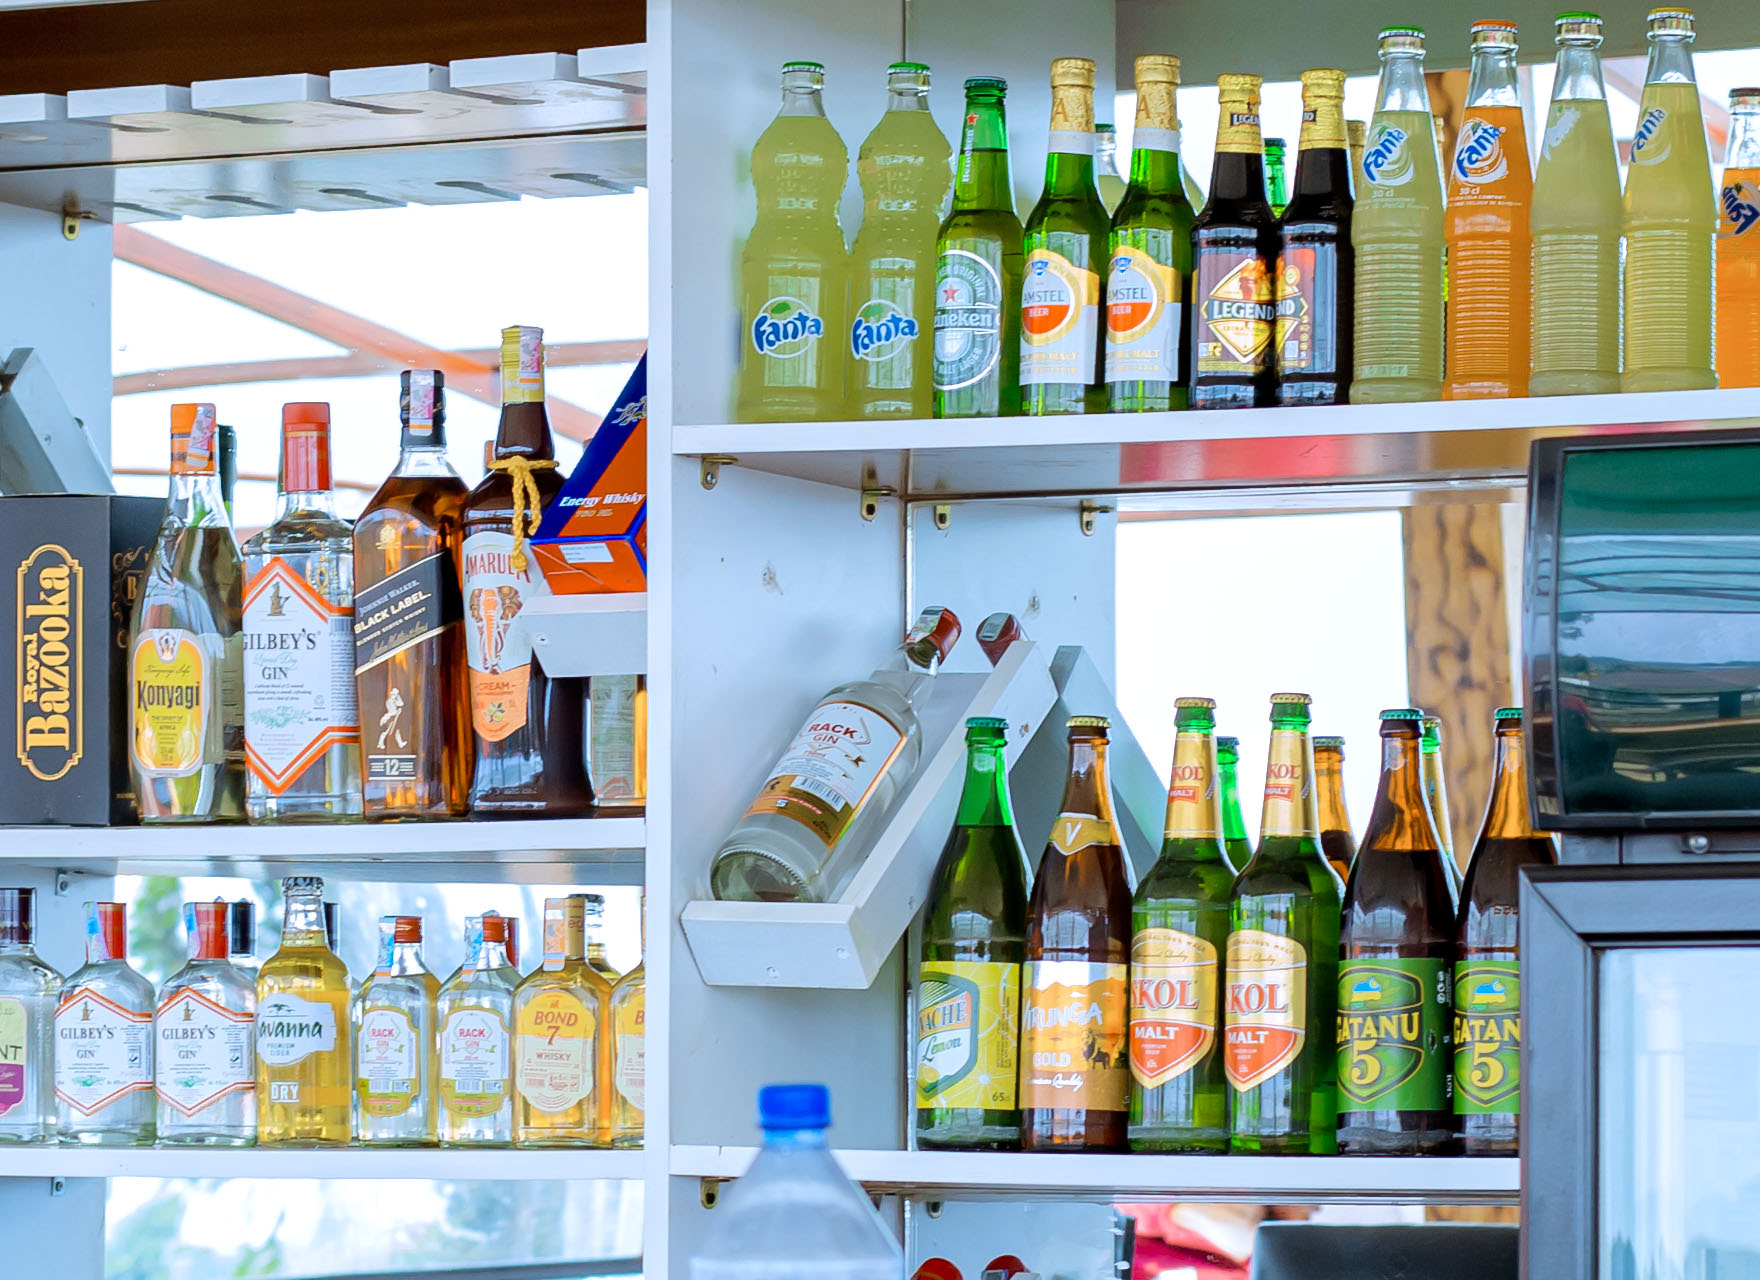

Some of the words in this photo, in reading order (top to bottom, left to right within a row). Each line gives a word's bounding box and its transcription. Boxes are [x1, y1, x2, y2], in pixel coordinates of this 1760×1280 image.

[1233, 114, 1260, 125] LEGEN
[1362, 128, 1408, 183] Fanta
[1455, 125, 1502, 179] Fanta
[1024, 290, 1065, 303] AMSTEL
[1107, 287, 1147, 300] AMSTEL
[1213, 301, 1274, 320] LEGEND
[752, 312, 823, 354] Fanta
[851, 313, 919, 359] Fanta
[558, 496, 602, 508] Energy
[602, 492, 646, 505] Whisky
[354, 608, 390, 634] BLACK
[26, 564, 71, 751] Bazooka
[24, 632, 40, 703] Royal
[262, 667, 288, 680] GIN
[137, 681, 200, 711] Konyagi
[808, 723, 858, 739] RACK
[813, 734, 839, 744] GIN
[384, 759, 401, 775] 12
[1172, 766, 1203, 781] KOL
[1266, 763, 1299, 780] KOL
[1065, 822, 1082, 846] V
[1226, 984, 1288, 1015] KOL
[534, 1011, 578, 1026] BOND
[60, 1025, 115, 1040] GILBEY'S
[161, 1025, 216, 1040] GILBEY'S
[258, 1020, 323, 1039] avanna
[371, 1028, 395, 1038] RACK
[459, 1028, 486, 1038] RACK
[546, 1025, 560, 1046] 7
[1135, 1026, 1179, 1039] MALT
[1228, 1031, 1269, 1044] MALT
[1453, 1015, 1520, 1044] GATAN
[77, 1049, 95, 1059] GIN
[178, 1049, 197, 1059] GIN
[536, 1052, 572, 1061] WHISKY
[922, 1035, 962, 1062] Lemon
[1032, 1051, 1071, 1068] GOLD
[1351, 1039, 1383, 1086] 5
[1470, 1042, 1506, 1090] 5
[271, 1084, 299, 1100] DRY
